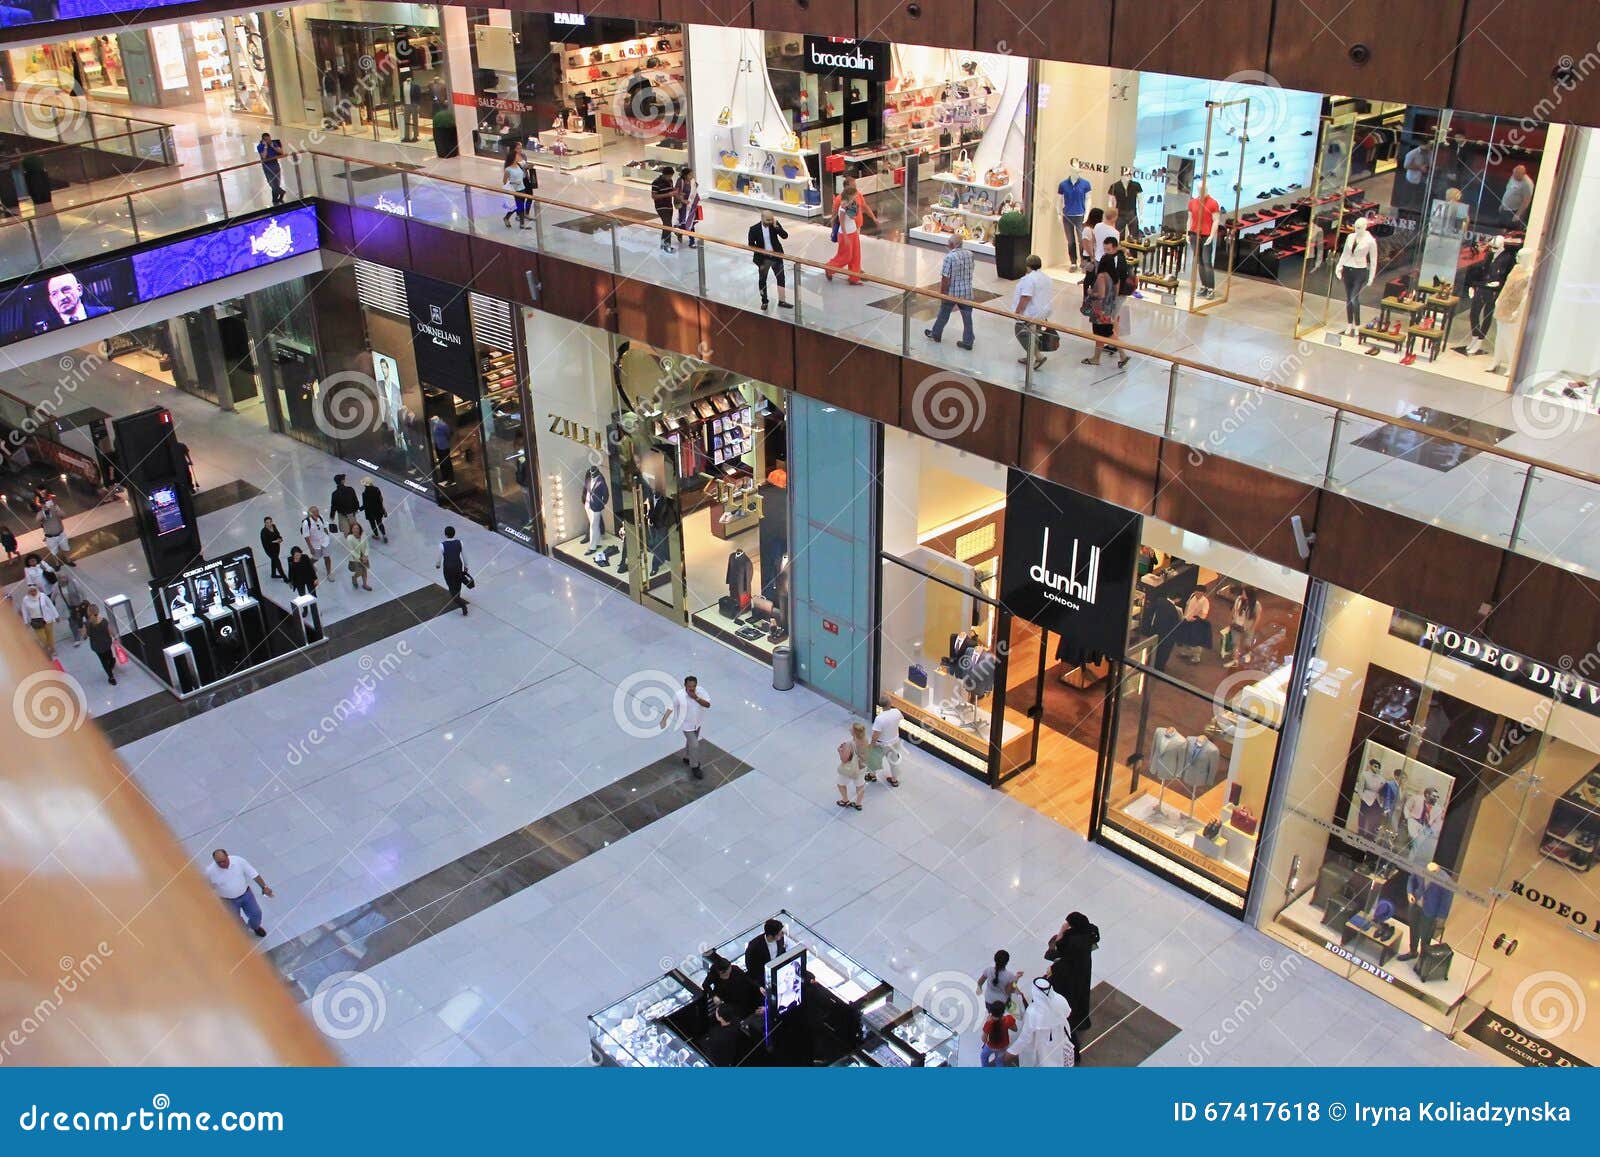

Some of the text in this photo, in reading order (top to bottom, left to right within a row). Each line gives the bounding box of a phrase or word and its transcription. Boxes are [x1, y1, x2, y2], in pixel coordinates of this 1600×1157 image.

[811, 43, 874, 71] braccialini
[1070, 157, 1109, 174] CESARE
[416, 322, 462, 345] CORNELIANI
[1029, 526, 1101, 605] dunhill
[1043, 591, 1080, 611] LONDON
[1424, 622, 1520, 672] RODEO
[1510, 880, 1587, 925] RODEO
[1325, 942, 1394, 984] RODEO DRIVE
[1487, 1019, 1553, 1059] RODEO
[1505, 1043, 1538, 1064] LUXURY
